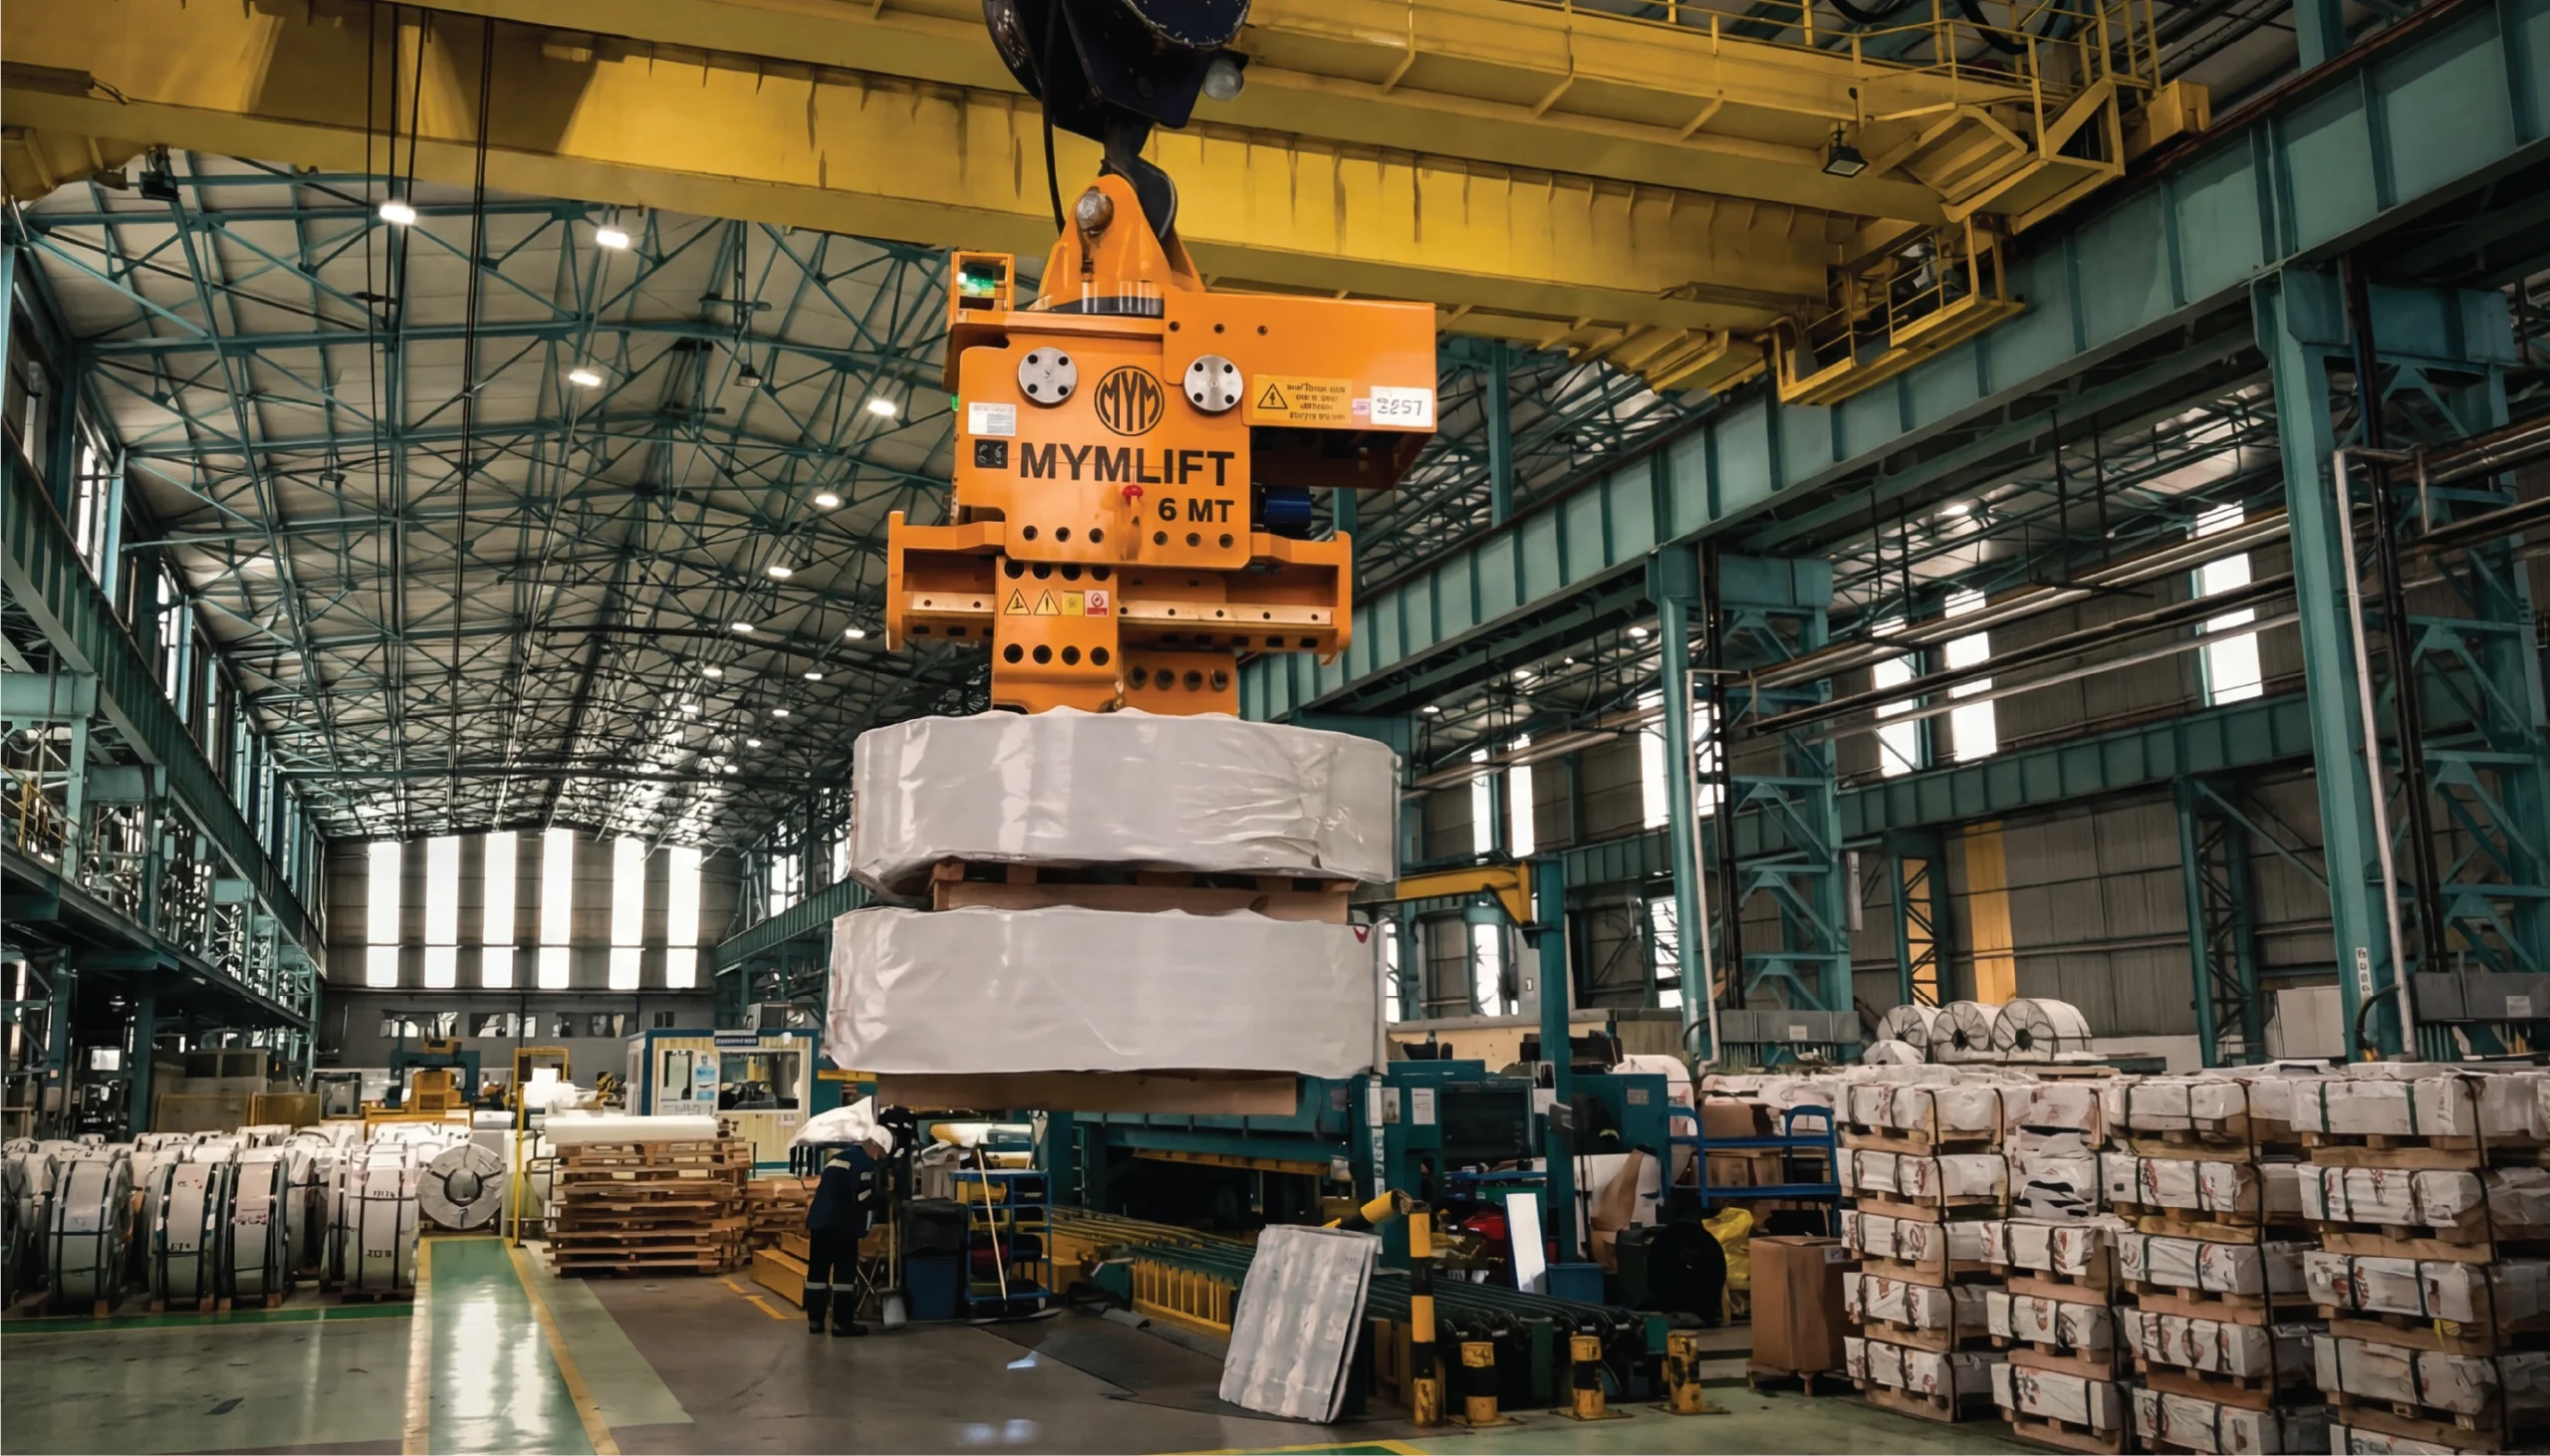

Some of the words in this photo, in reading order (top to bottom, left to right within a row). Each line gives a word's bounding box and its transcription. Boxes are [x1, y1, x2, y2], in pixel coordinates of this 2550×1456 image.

[1099, 369, 1160, 432] MYM
[1020, 442, 1235, 487] MYMLIFT
[1157, 497, 1177, 522] 6
[1187, 498, 1234, 523] MT
